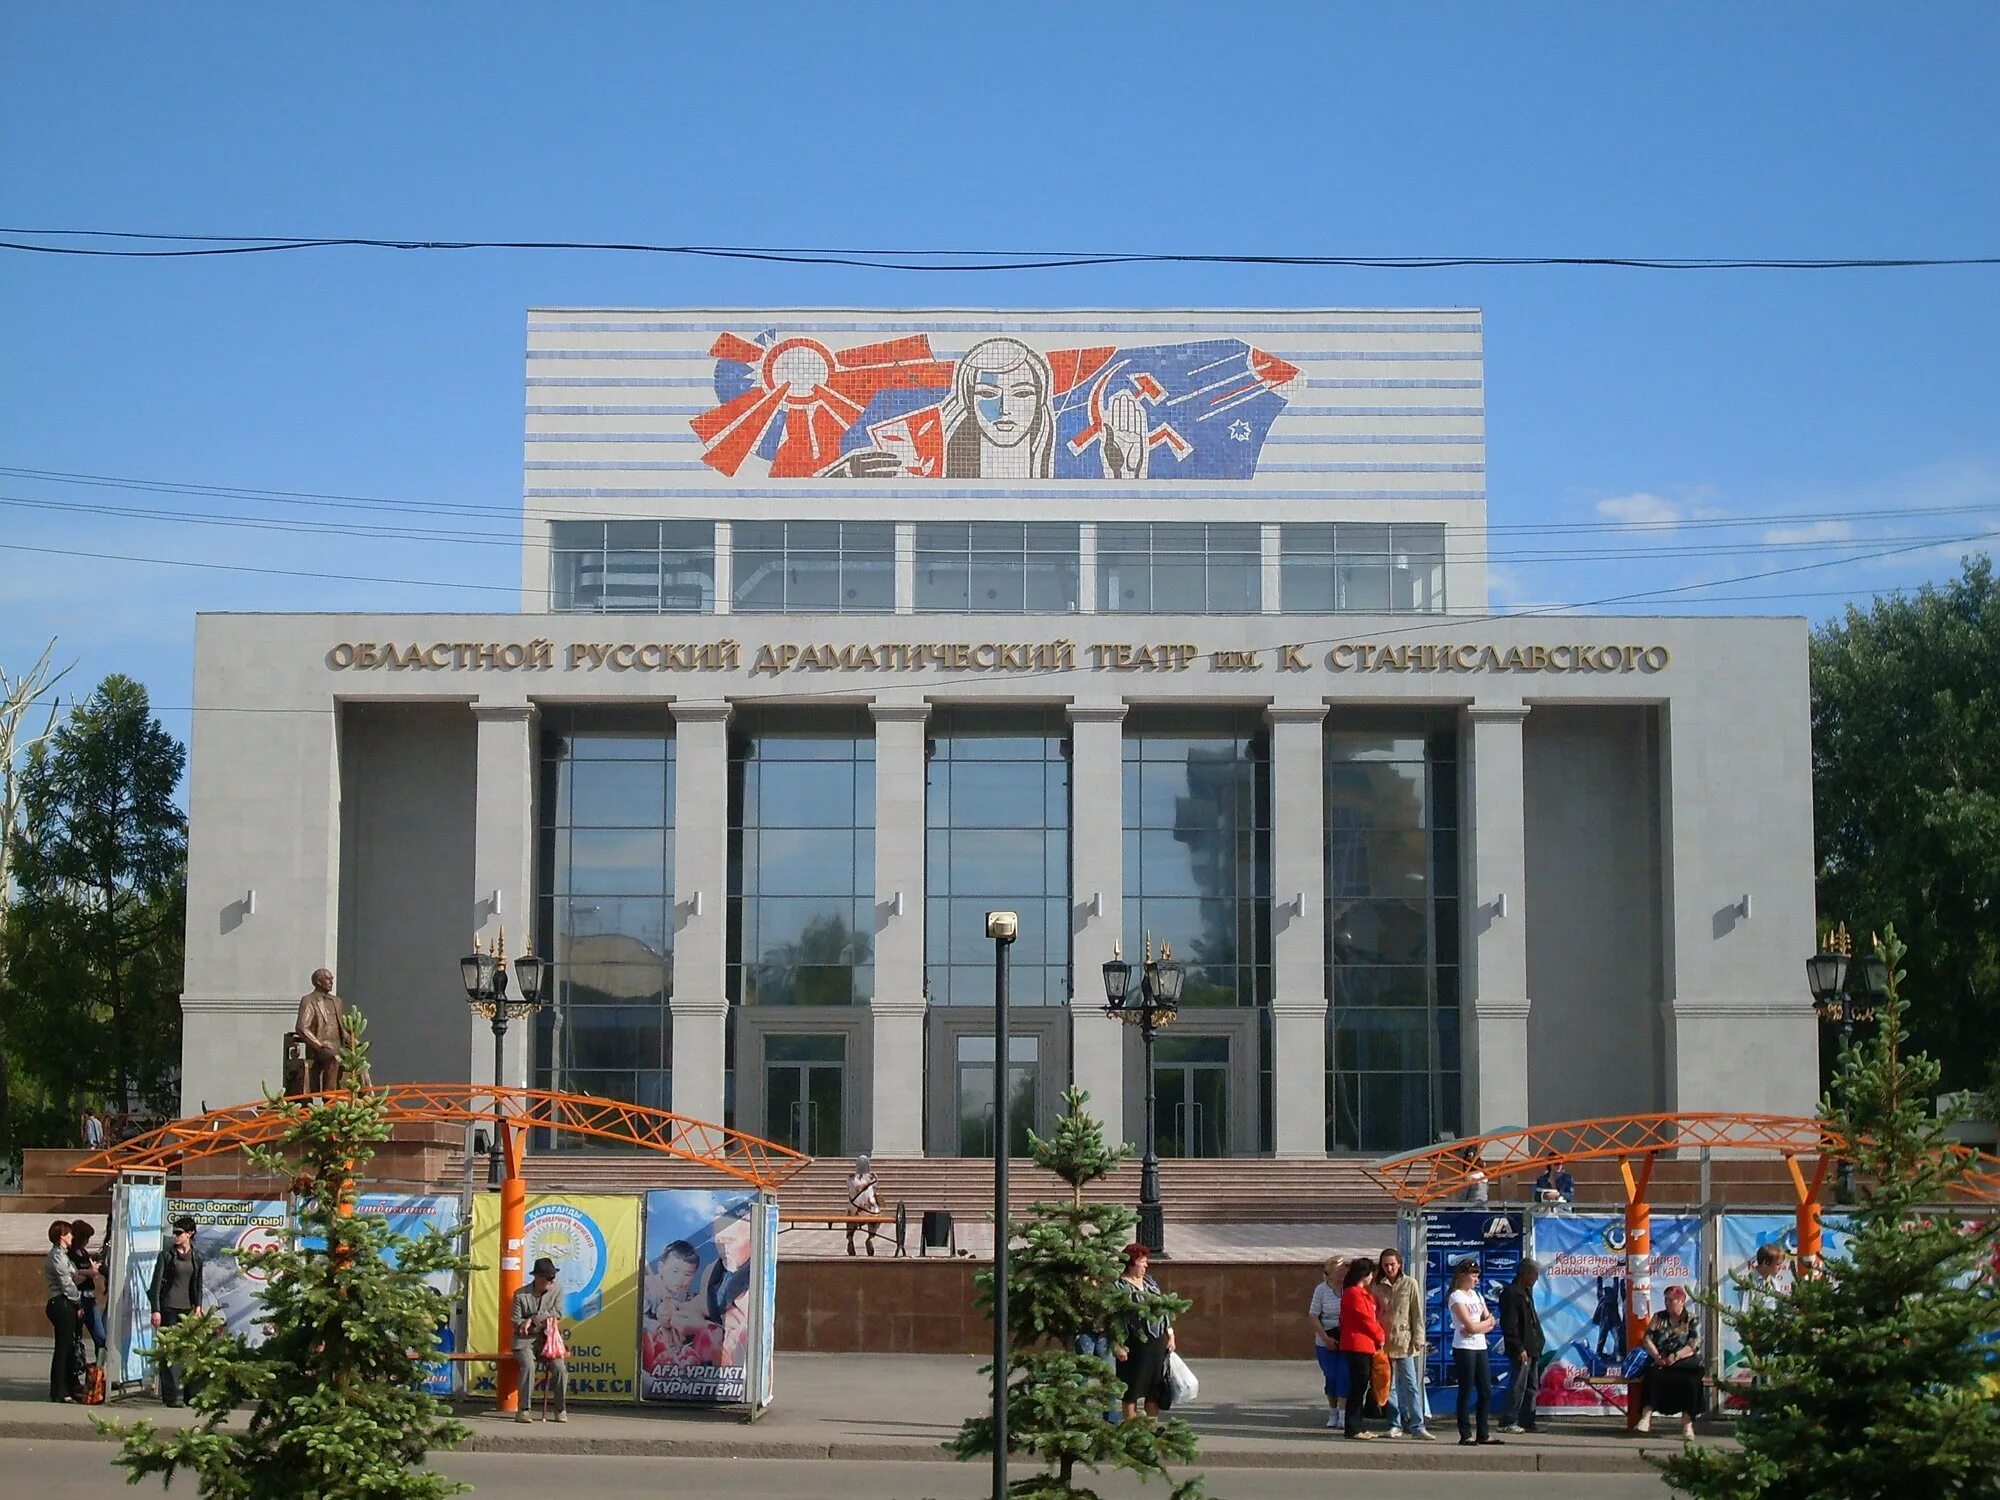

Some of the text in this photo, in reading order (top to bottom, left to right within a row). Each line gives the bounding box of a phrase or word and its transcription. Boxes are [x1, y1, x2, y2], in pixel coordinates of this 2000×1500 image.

[331, 638, 554, 669] ОБЛАСТНОЙ
[571, 638, 741, 669] РУССКИЙ
[755, 638, 1075, 673] ДРАМАТИЧЕСКИЙ
[1094, 642, 1198, 668] ТЕАТР
[1332, 642, 1671, 671] СТАНИСЛАВСКОГО
